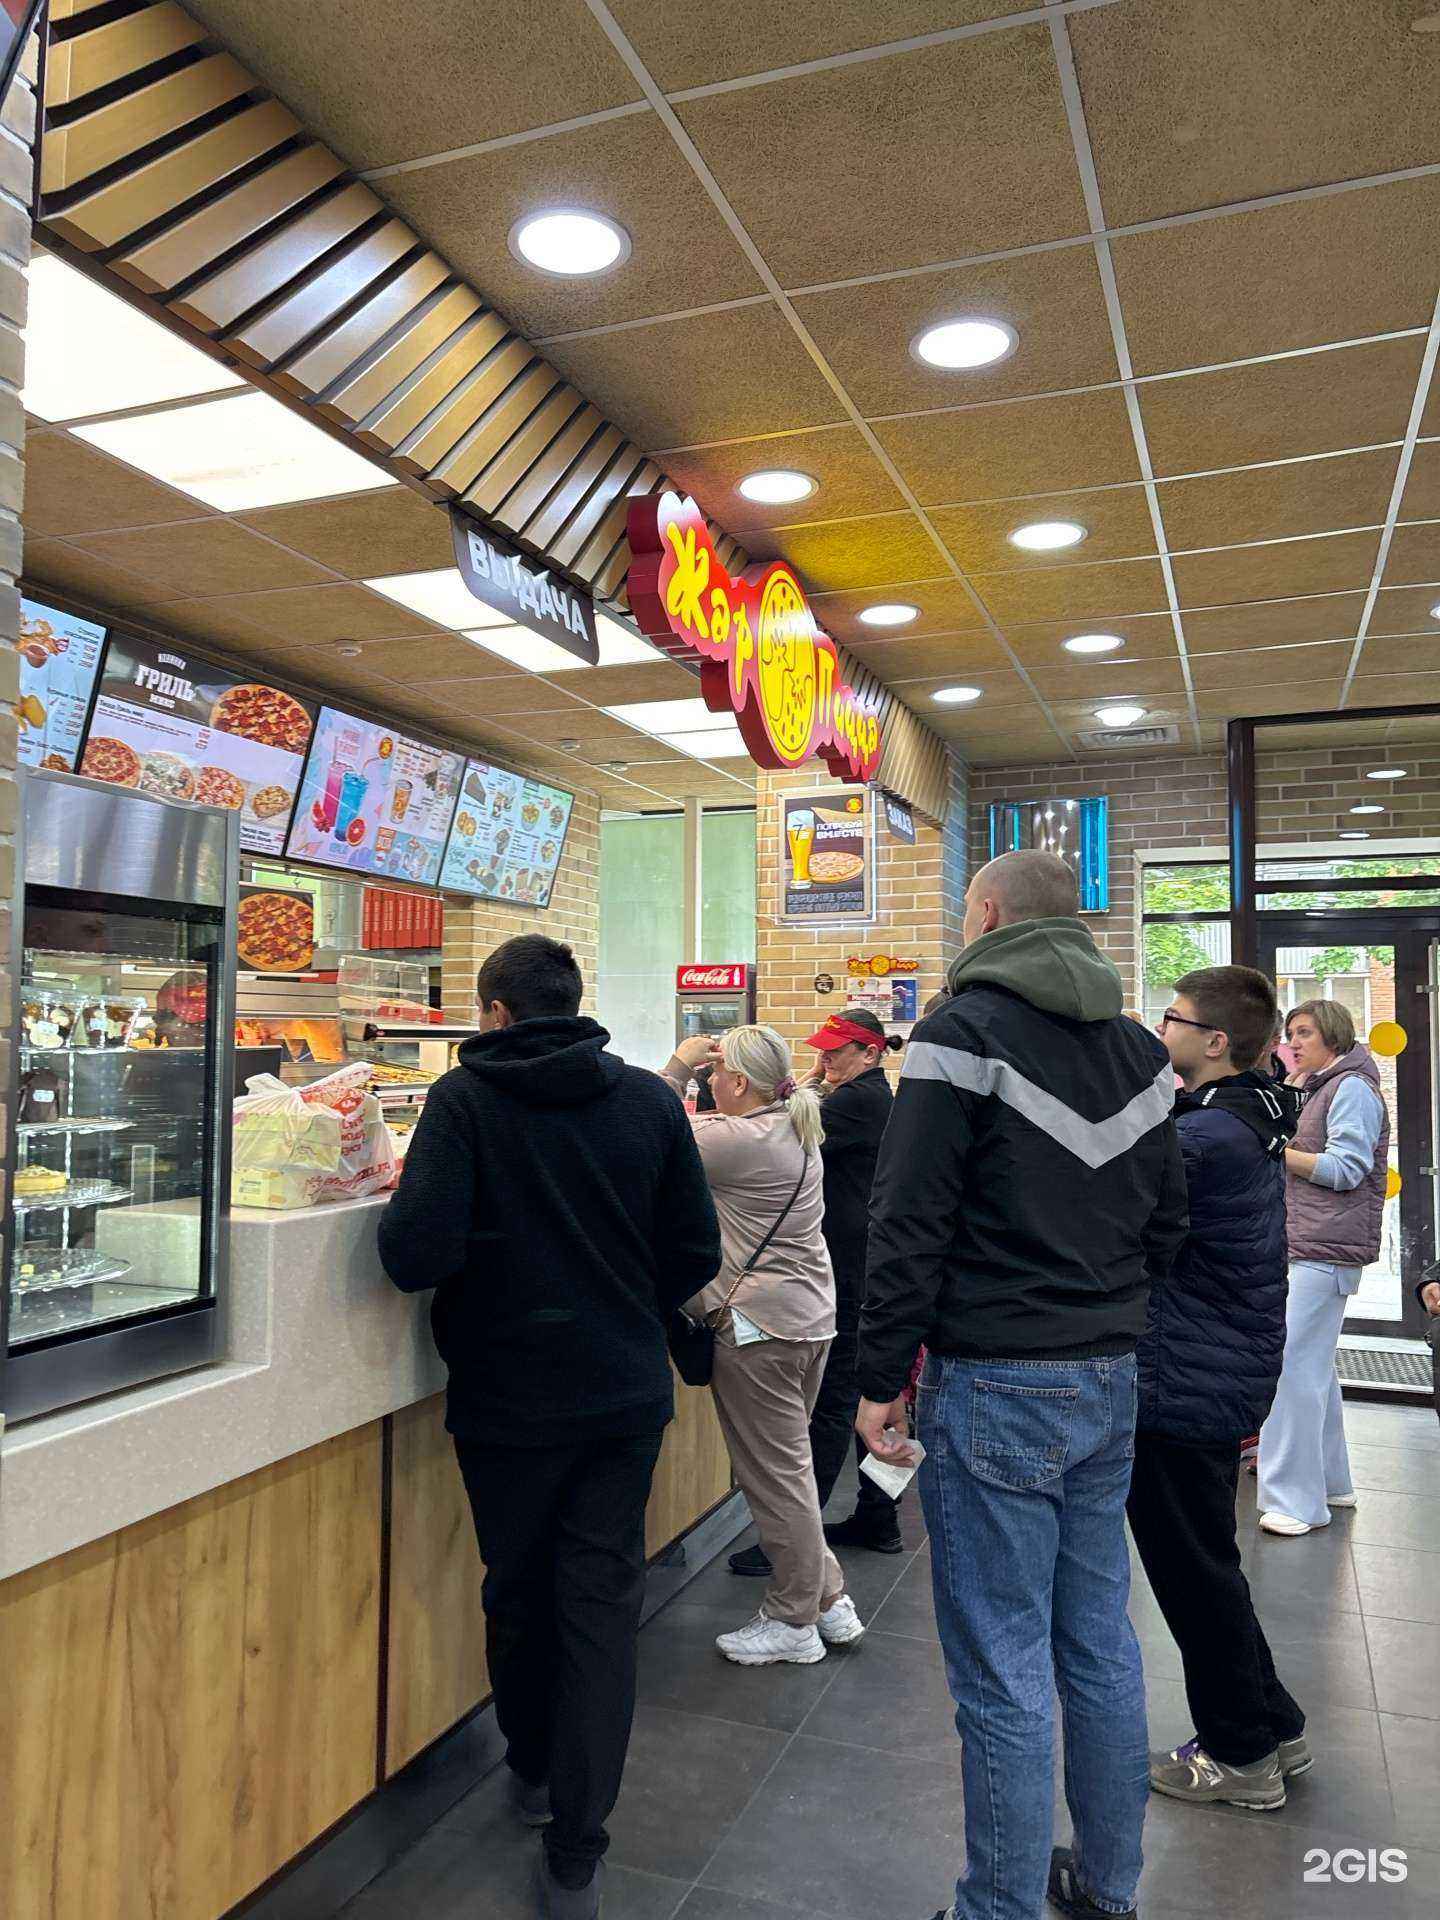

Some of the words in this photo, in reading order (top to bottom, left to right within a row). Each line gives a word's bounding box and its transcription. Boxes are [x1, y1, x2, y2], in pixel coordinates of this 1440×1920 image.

[467, 529, 590, 642] ВЫДАЧА
[667, 521, 754, 695] Жар
[817, 647, 878, 766] Пицца
[135, 664, 196, 702] ГРИЛЬ
[681, 968, 734, 986] Coca-Cola
